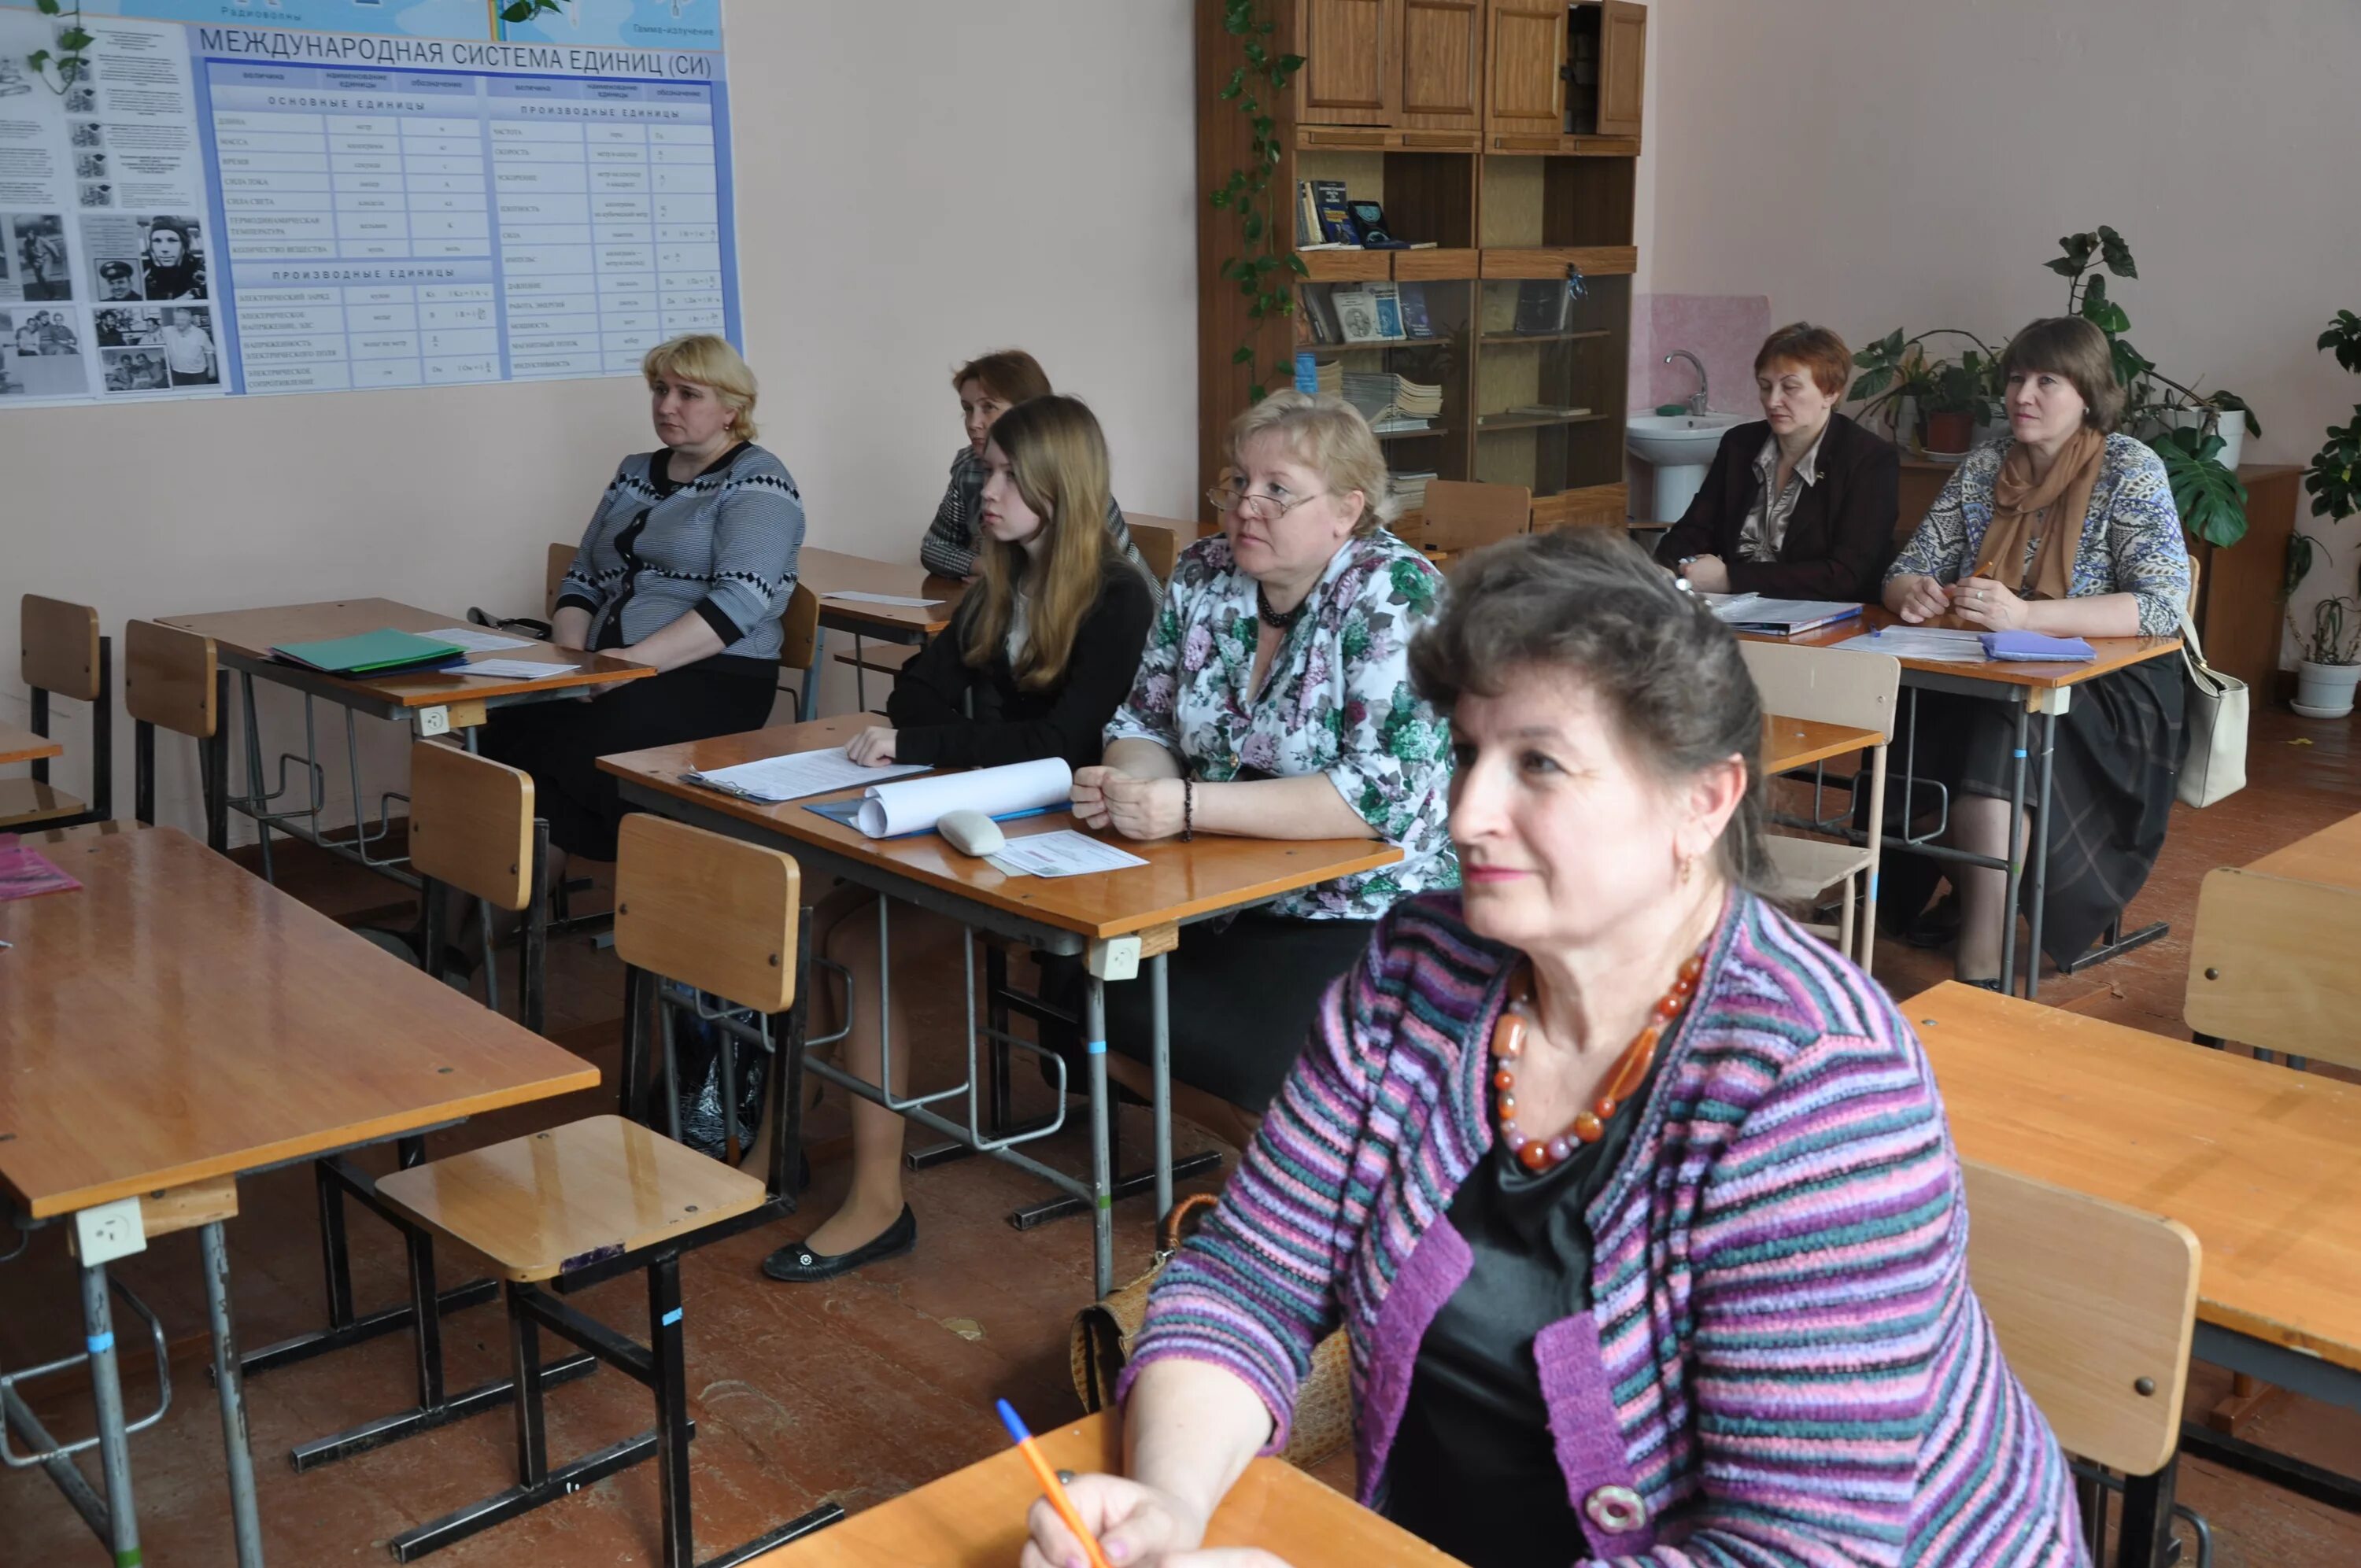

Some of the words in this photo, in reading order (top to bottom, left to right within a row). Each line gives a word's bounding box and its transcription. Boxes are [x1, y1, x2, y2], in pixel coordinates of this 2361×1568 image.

[221, 6, 302, 20] Радиоволны
[633, 24, 715, 37] Гамма-излучение
[199, 28, 444, 65] МЕЖДУНАРОДНАЯ
[452, 43, 563, 69] СИСТЕМА
[570, 50, 663, 76] ЕДИНИЦ
[668, 55, 712, 79] (СИ)
[268, 96, 349, 109] ОСНОВНЫЕ
[357, 99, 426, 111] ЕДИНИЦЫ
[520, 105, 615, 116] ПРОИЗВОДНЫЕ
[622, 109, 680, 119] ЕДИНИЦЫ
[272, 270, 381, 280] ПРОИЗВОДНЫЕ
[390, 269, 455, 279] ЕДИНИЦЫ
